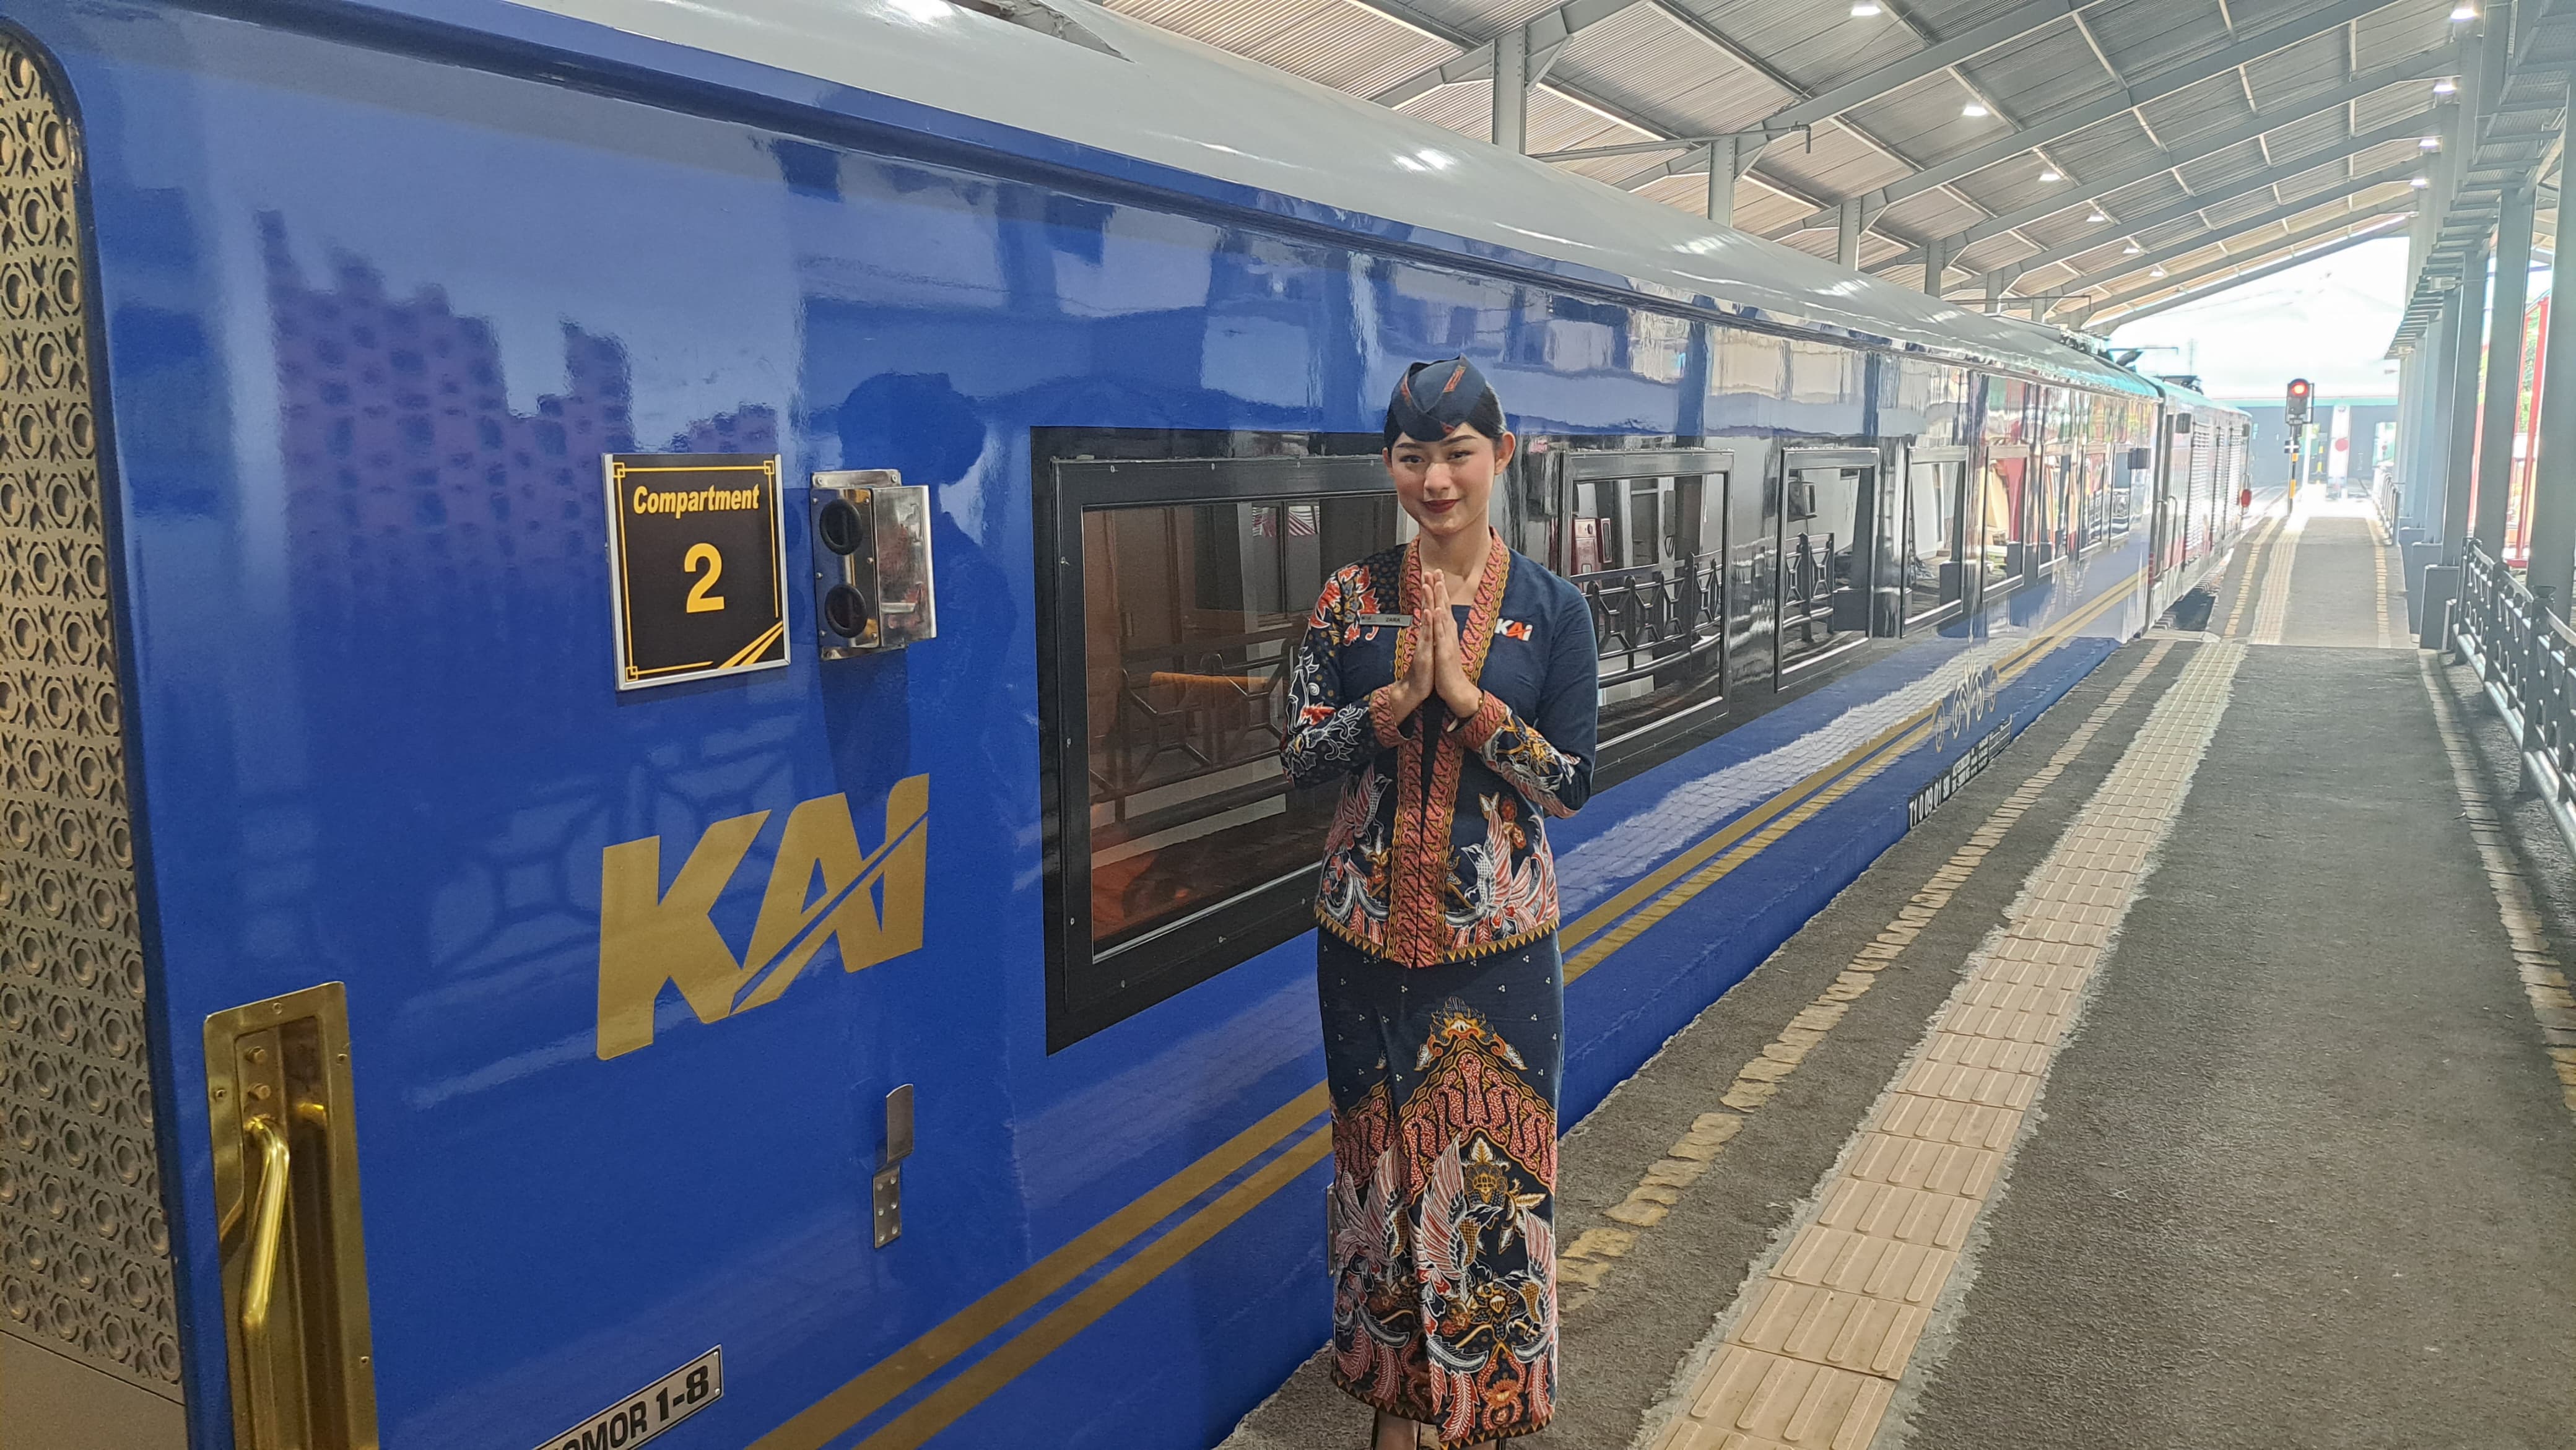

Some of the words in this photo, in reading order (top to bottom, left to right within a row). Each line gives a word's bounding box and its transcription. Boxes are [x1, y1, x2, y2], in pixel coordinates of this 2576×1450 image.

[633, 484, 760, 519] Compartment
[684, 543, 725, 613] 2
[1494, 618, 1533, 641] KAI
[1909, 799, 1917, 829] T1
[596, 773, 929, 1061] KAI
[555, 1400, 647, 1450] MOR
[656, 1365, 709, 1422] 1-8
